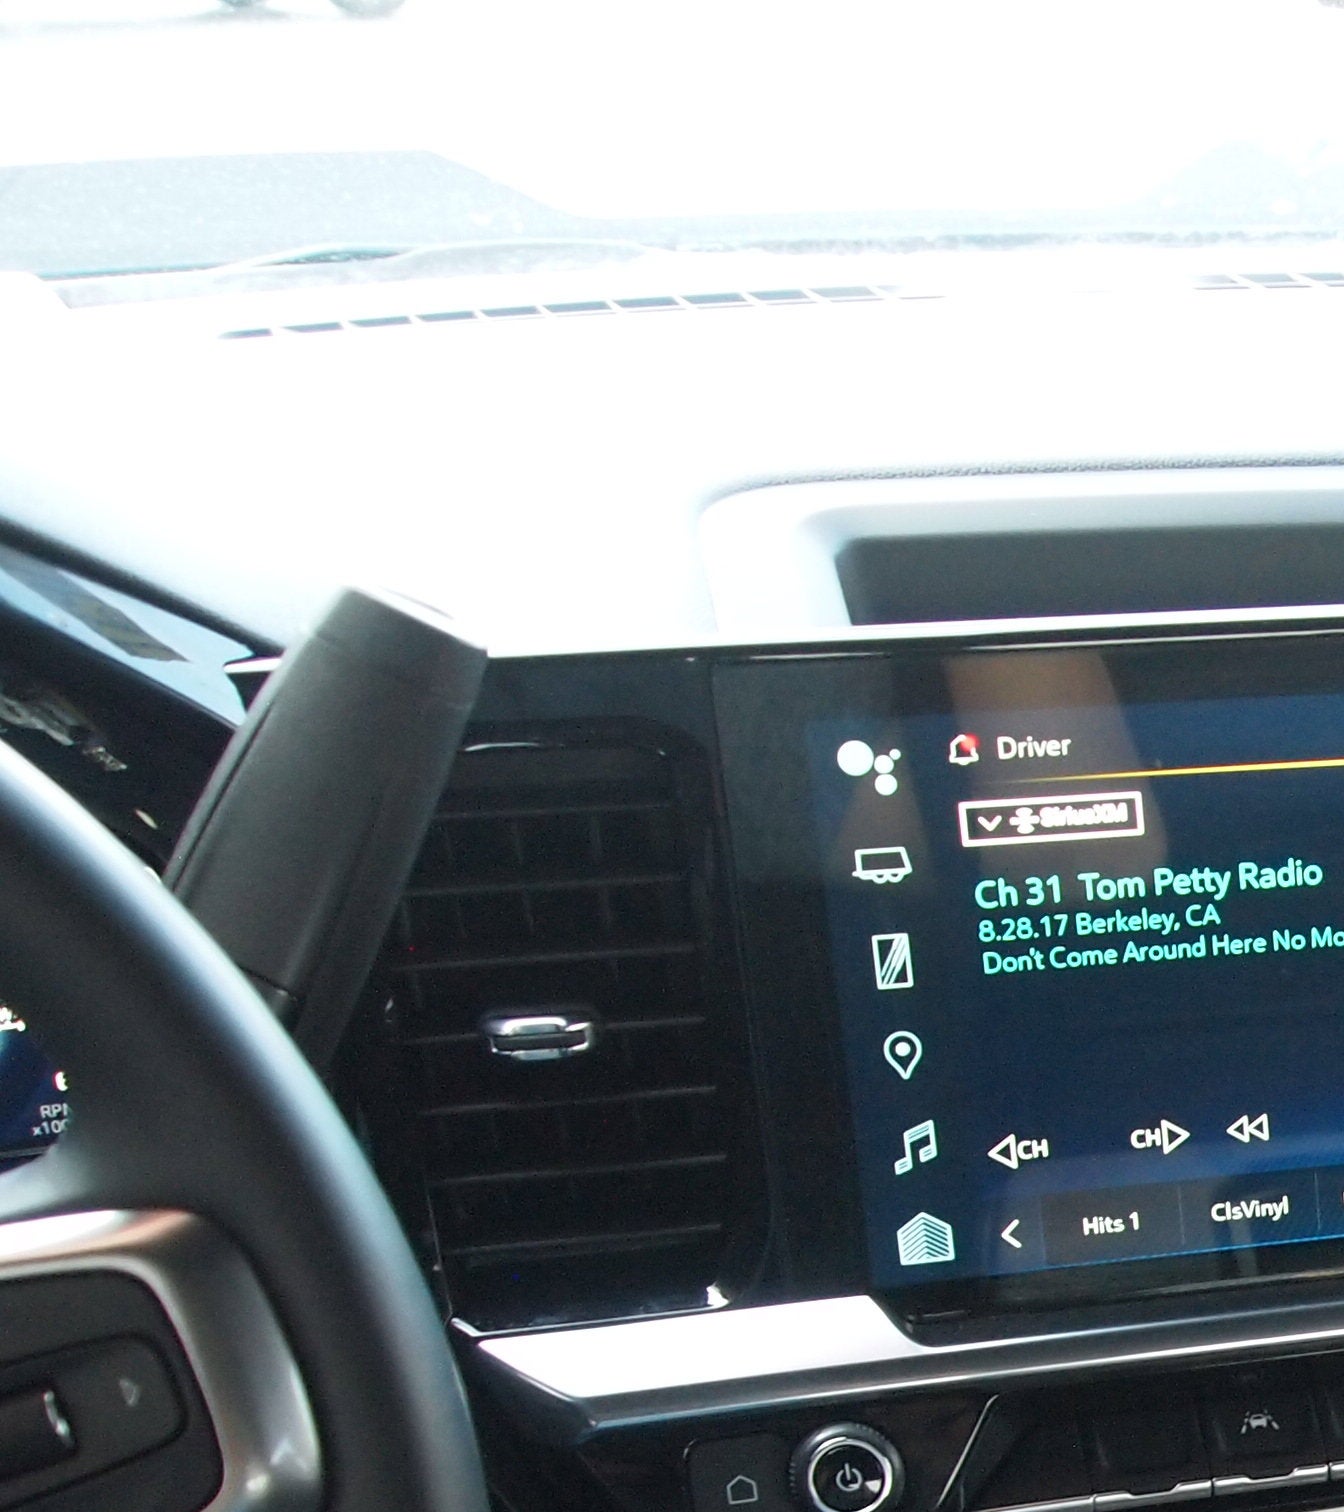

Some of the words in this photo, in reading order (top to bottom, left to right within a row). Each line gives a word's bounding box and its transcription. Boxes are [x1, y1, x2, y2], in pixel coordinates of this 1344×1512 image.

[997, 736, 1071, 759] Driver
[975, 878, 1018, 909] Ch
[1025, 875, 1060, 905] 31
[1077, 872, 1145, 900] Tom
[1154, 867, 1231, 900] Petty
[1239, 858, 1322, 890] Radio
[979, 914, 1068, 942] 8.28.17
[1076, 908, 1180, 935] Berkeley,
[1186, 904, 1221, 926] CA
[983, 948, 1045, 974] Don't
[1050, 946, 1118, 968] Come
[1123, 935, 1206, 963] Around
[1212, 934, 1267, 955] Here
[1273, 929, 1306, 951] No
[1017, 1139, 1048, 1159] CH
[1131, 1128, 1161, 1148] CH
[1211, 1196, 1288, 1221] ClsVinyl
[1083, 1216, 1125, 1235] Hits
[1129, 1212, 1139, 1230] 1
